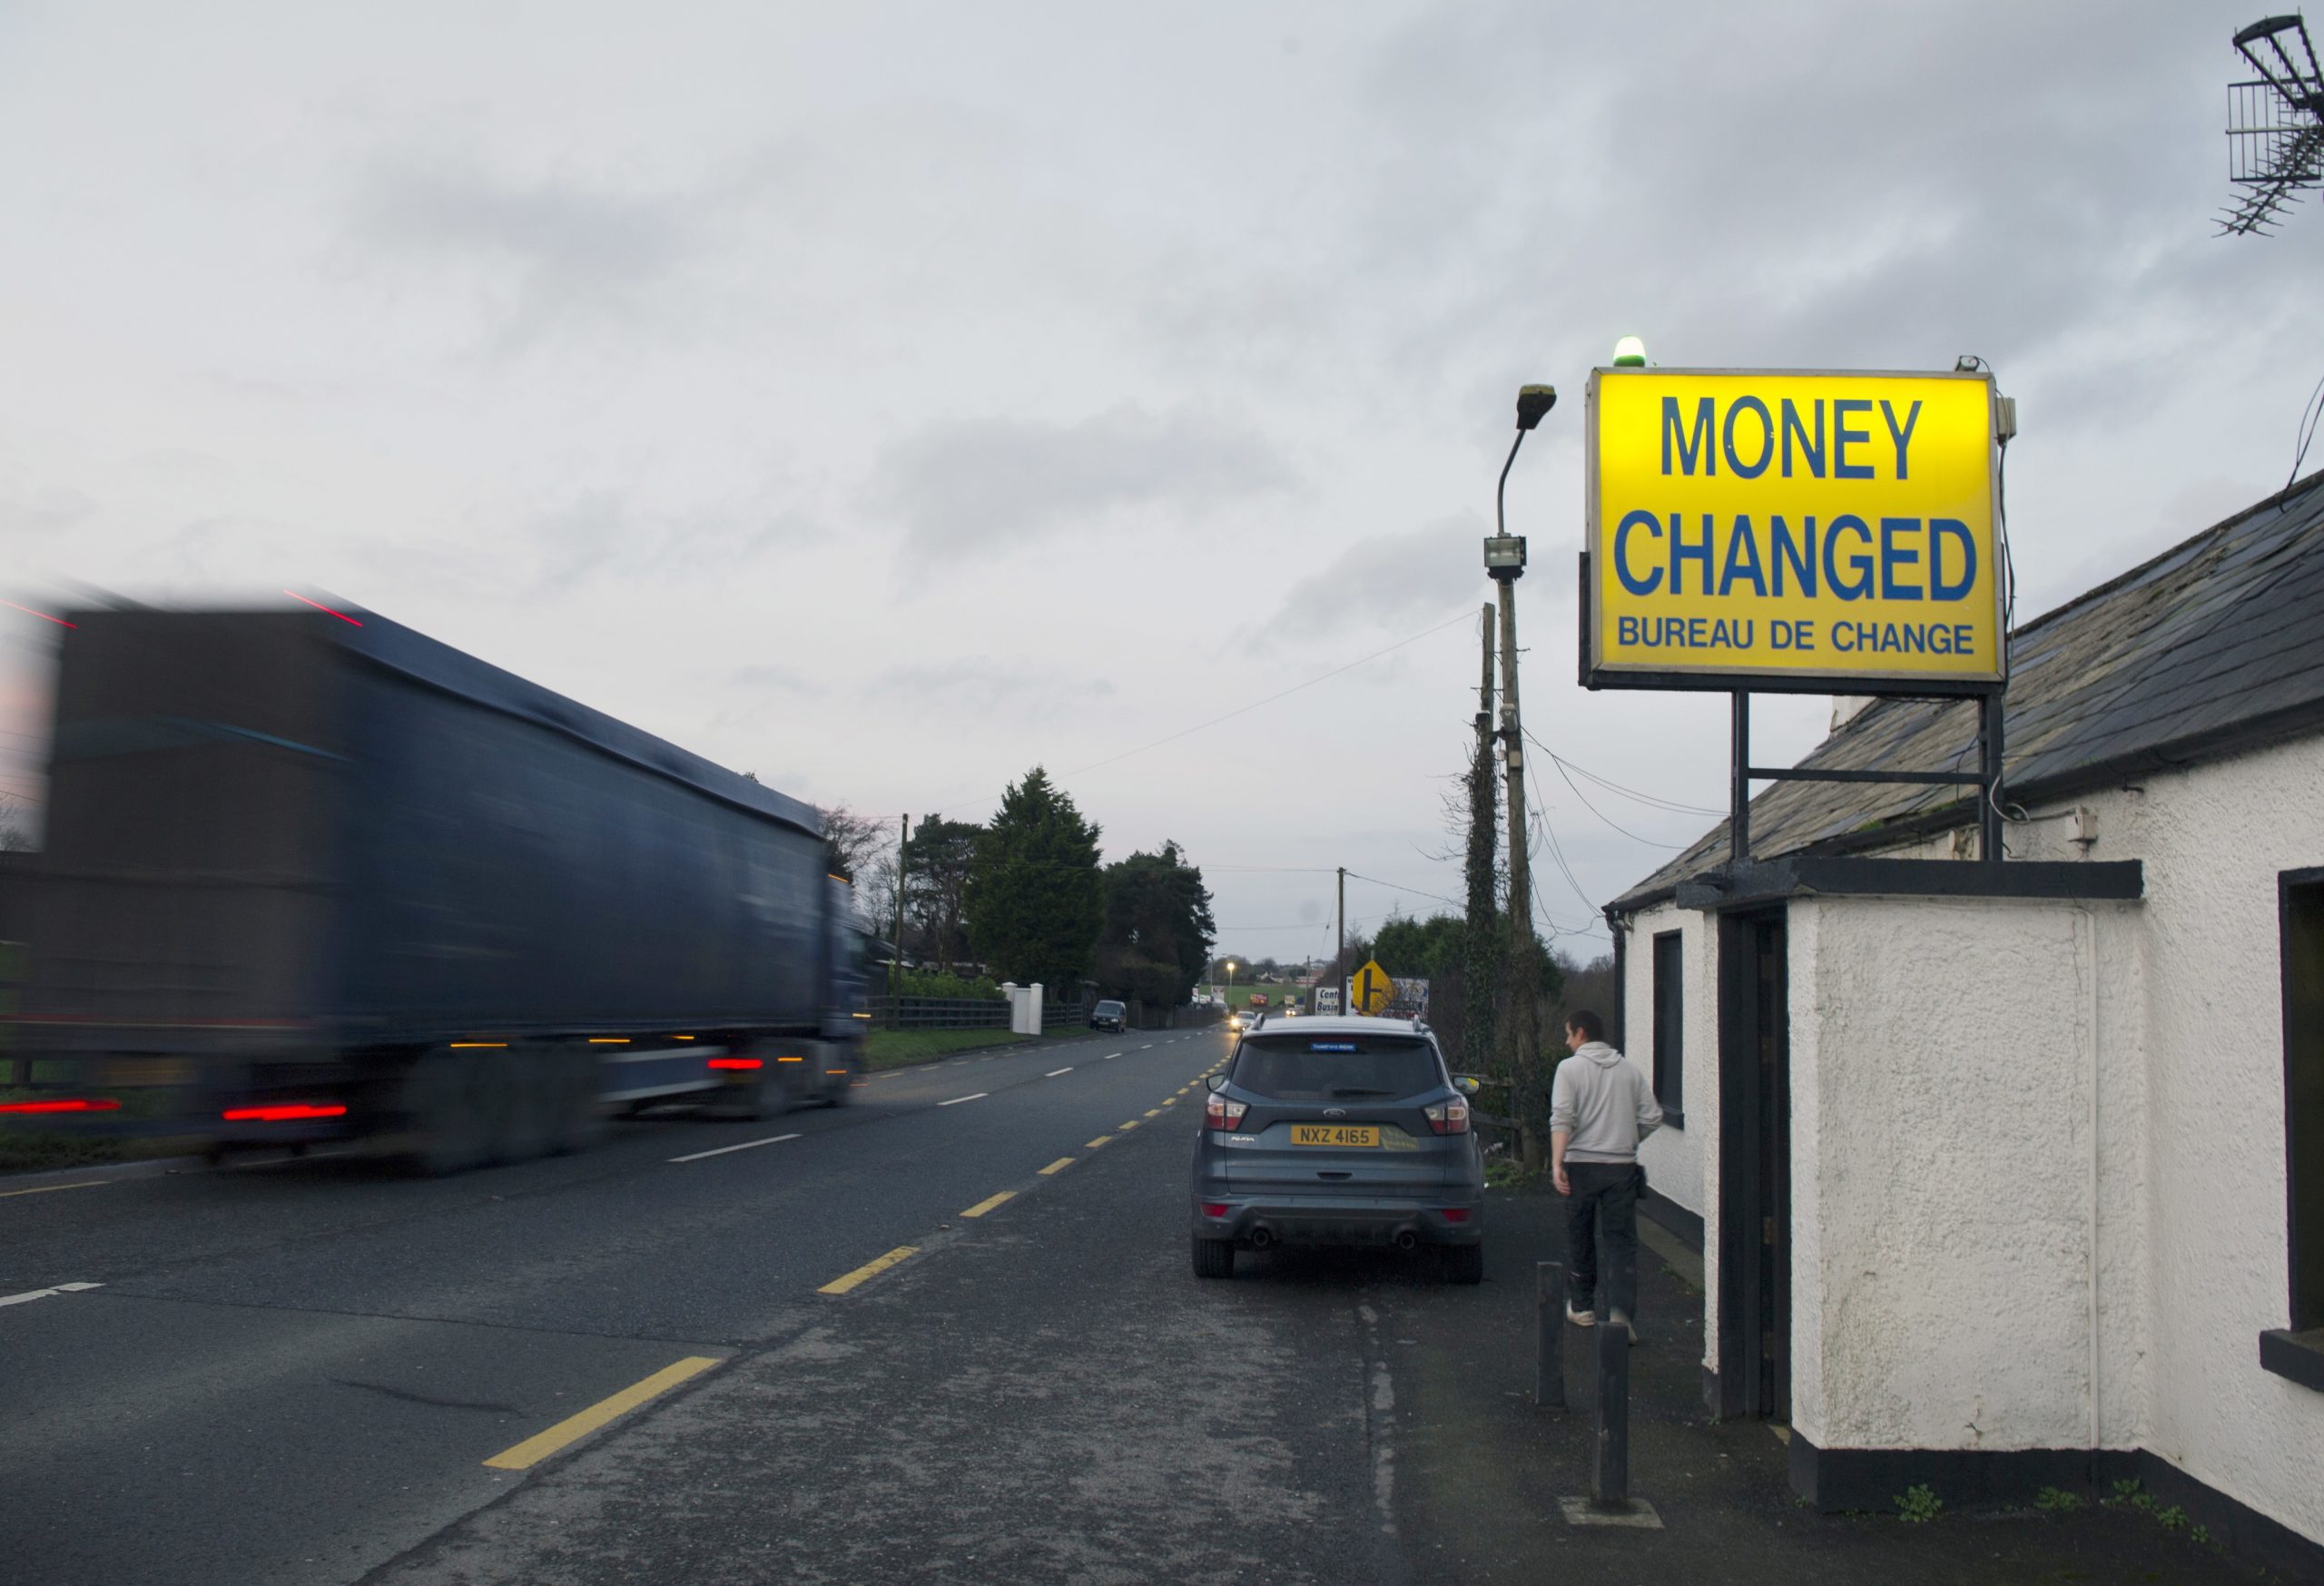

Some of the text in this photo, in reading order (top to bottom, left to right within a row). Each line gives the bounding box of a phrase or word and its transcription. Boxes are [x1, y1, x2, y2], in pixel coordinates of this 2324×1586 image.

[1663, 396, 1922, 479] MONEY
[1614, 510, 1977, 601] CHANGED
[1619, 616, 1974, 655] BUREAU DE CHANGE
[1317, 1002, 1338, 1011] Busin
[1320, 990, 1339, 999] Cent
[1301, 1128, 1369, 1144] NXZ 4165
